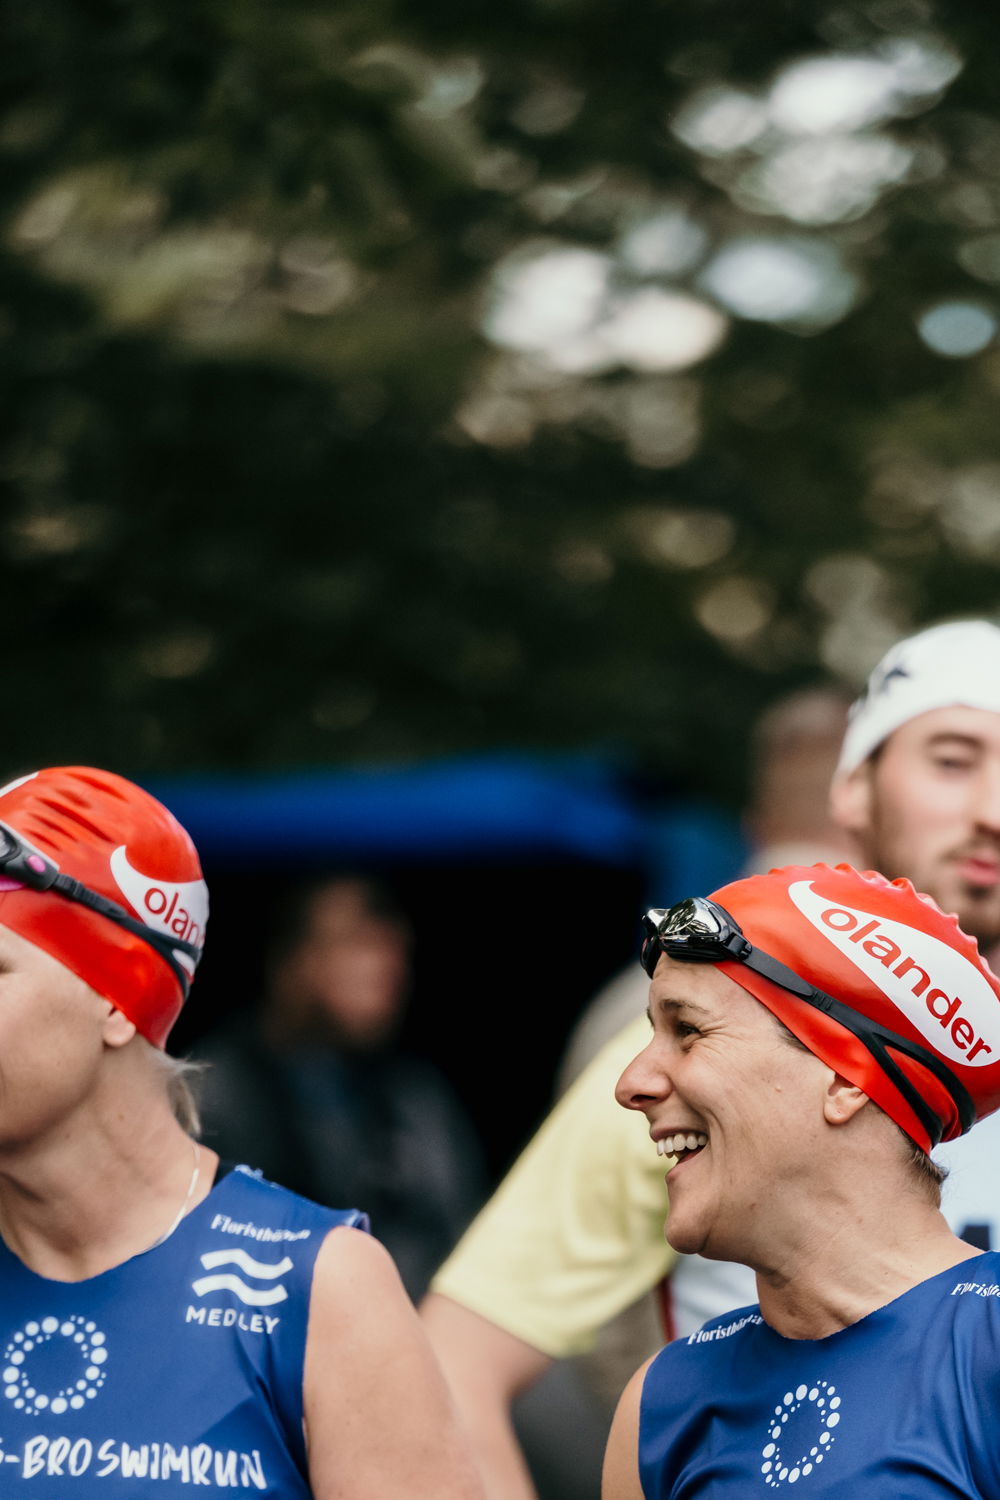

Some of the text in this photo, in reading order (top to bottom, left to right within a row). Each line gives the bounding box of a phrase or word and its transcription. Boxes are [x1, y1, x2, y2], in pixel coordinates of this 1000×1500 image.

[820, 907, 993, 1062] olander
[184, 1304, 281, 1335] MEDLEY
[0, 1434, 268, 1490] -BRO SWIMRUN
